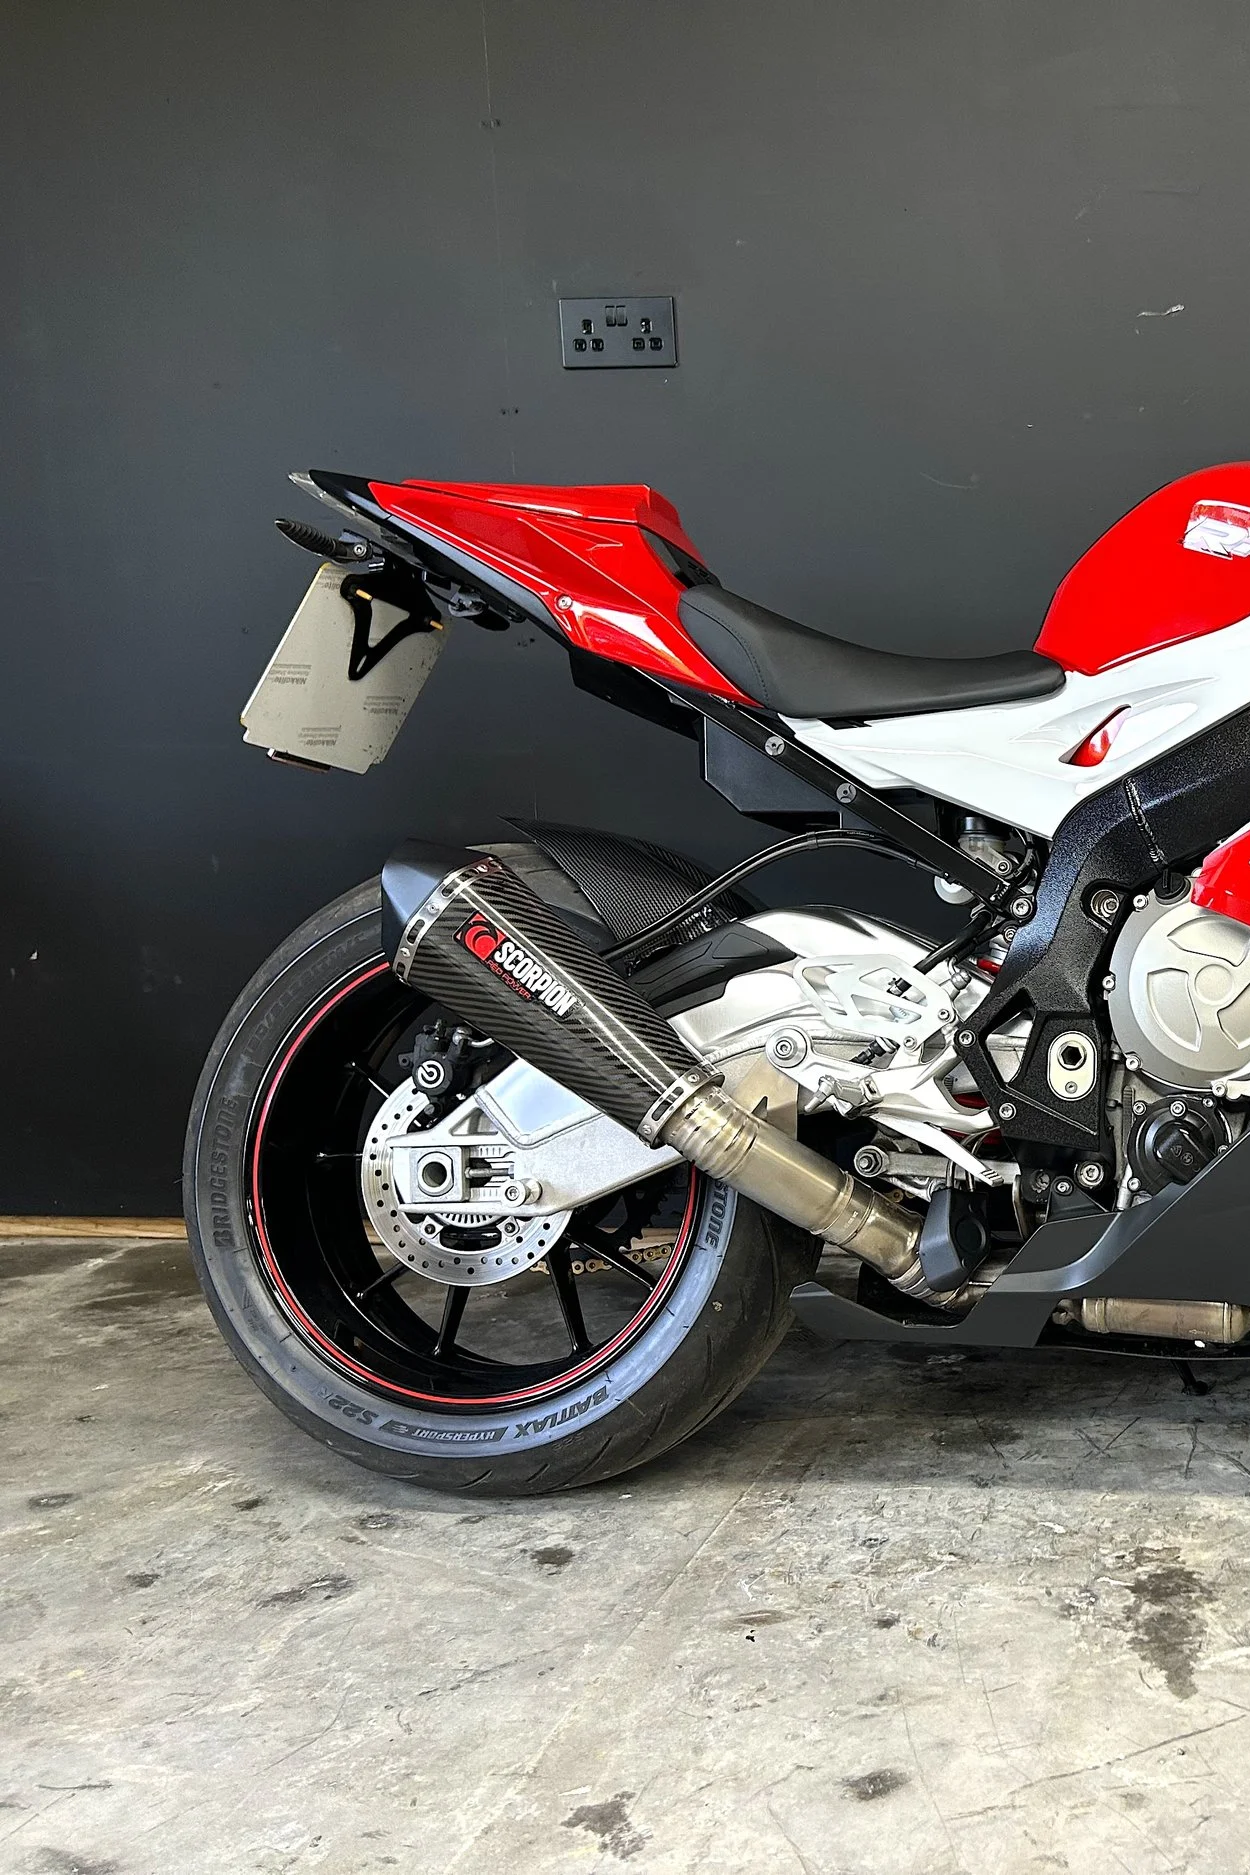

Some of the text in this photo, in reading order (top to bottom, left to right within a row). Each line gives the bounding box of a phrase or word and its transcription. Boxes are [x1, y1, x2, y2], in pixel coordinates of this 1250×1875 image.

[494, 941, 577, 1016] SCORPION
[211, 1096, 238, 1248] BRIDGESTONE
[412, 1428, 496, 1442] HYPERSPORT
